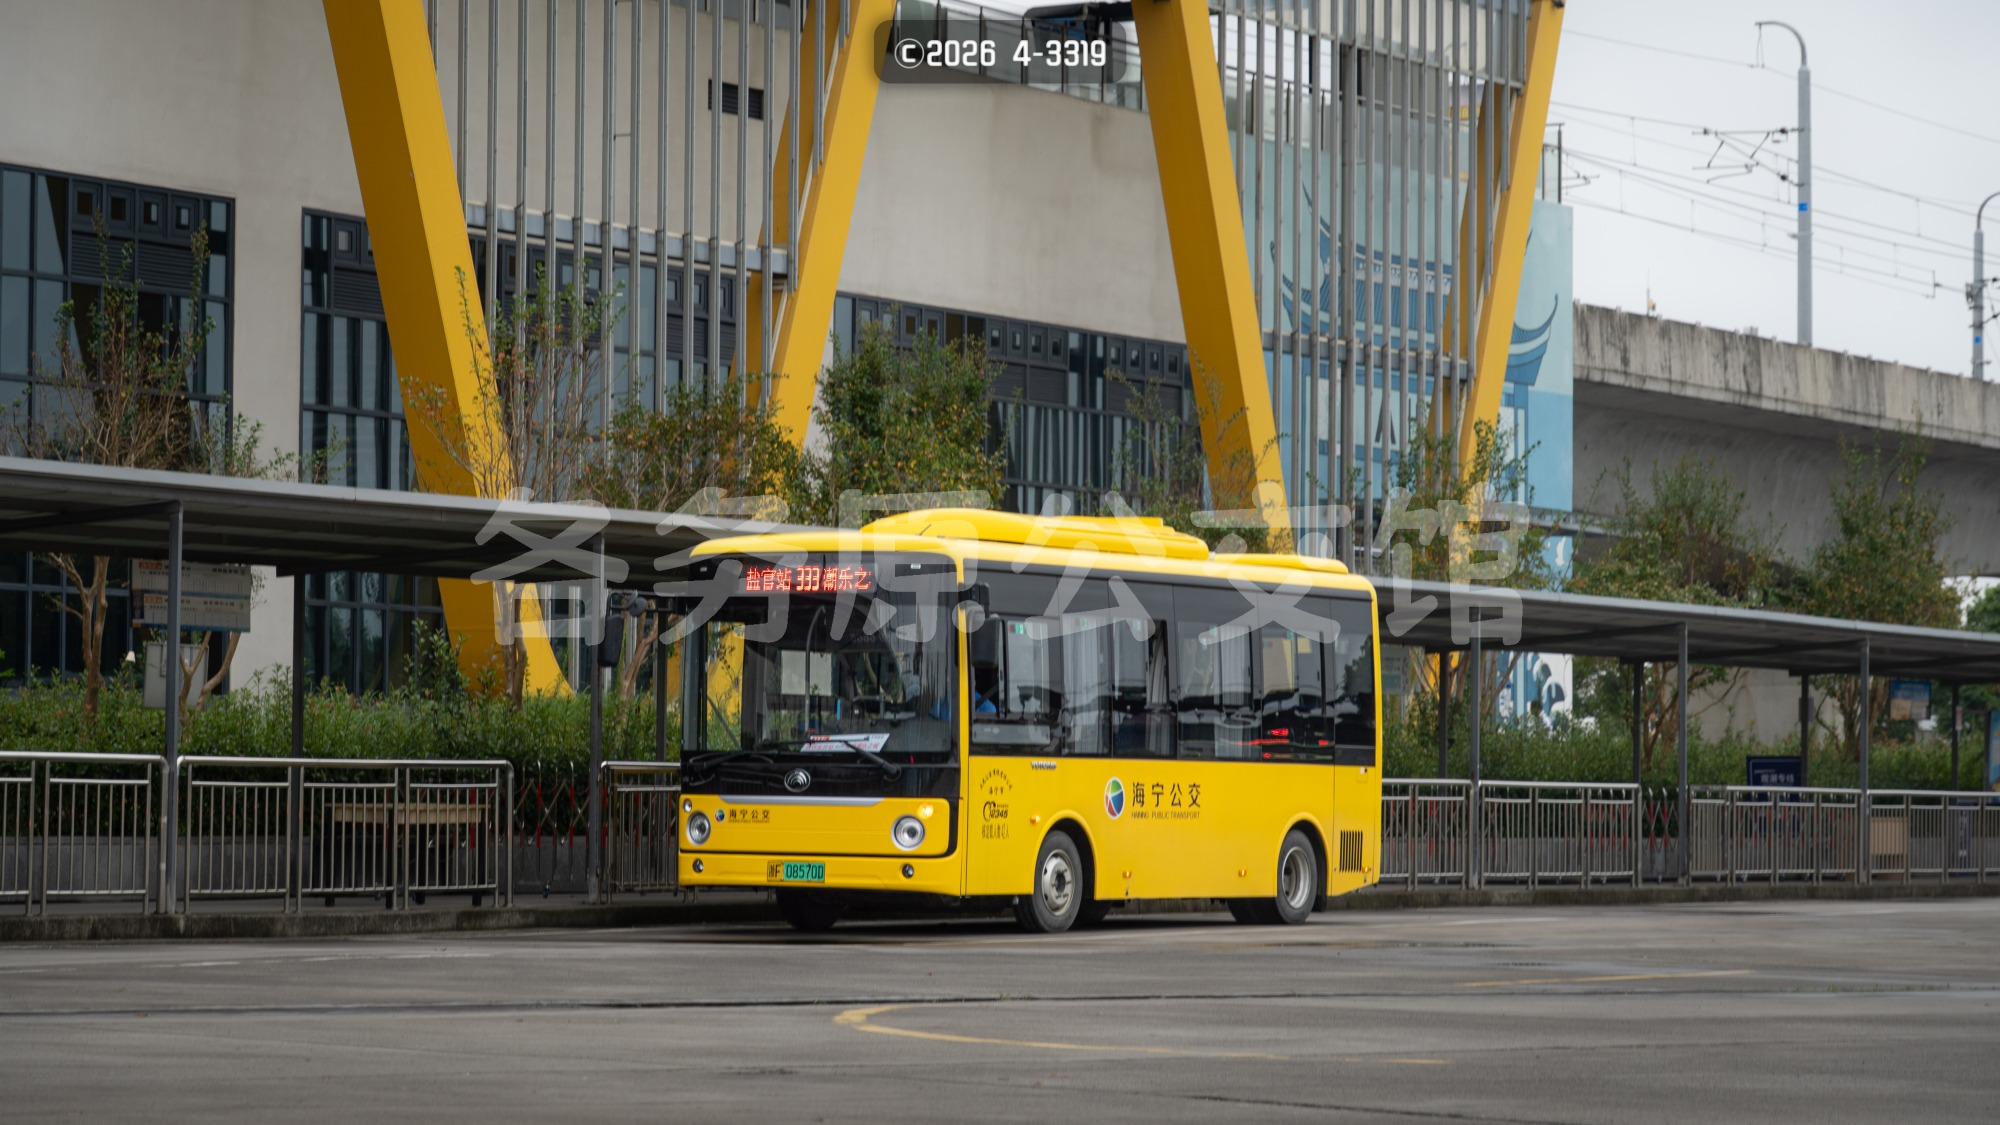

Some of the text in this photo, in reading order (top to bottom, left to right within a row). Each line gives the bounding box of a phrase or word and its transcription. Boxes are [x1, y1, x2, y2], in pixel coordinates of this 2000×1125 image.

[746, 566, 792, 591] 盐官站
[796, 565, 820, 592] 333
[1132, 781, 1201, 808] 海宁公交
[729, 808, 770, 819] 海宁公交
